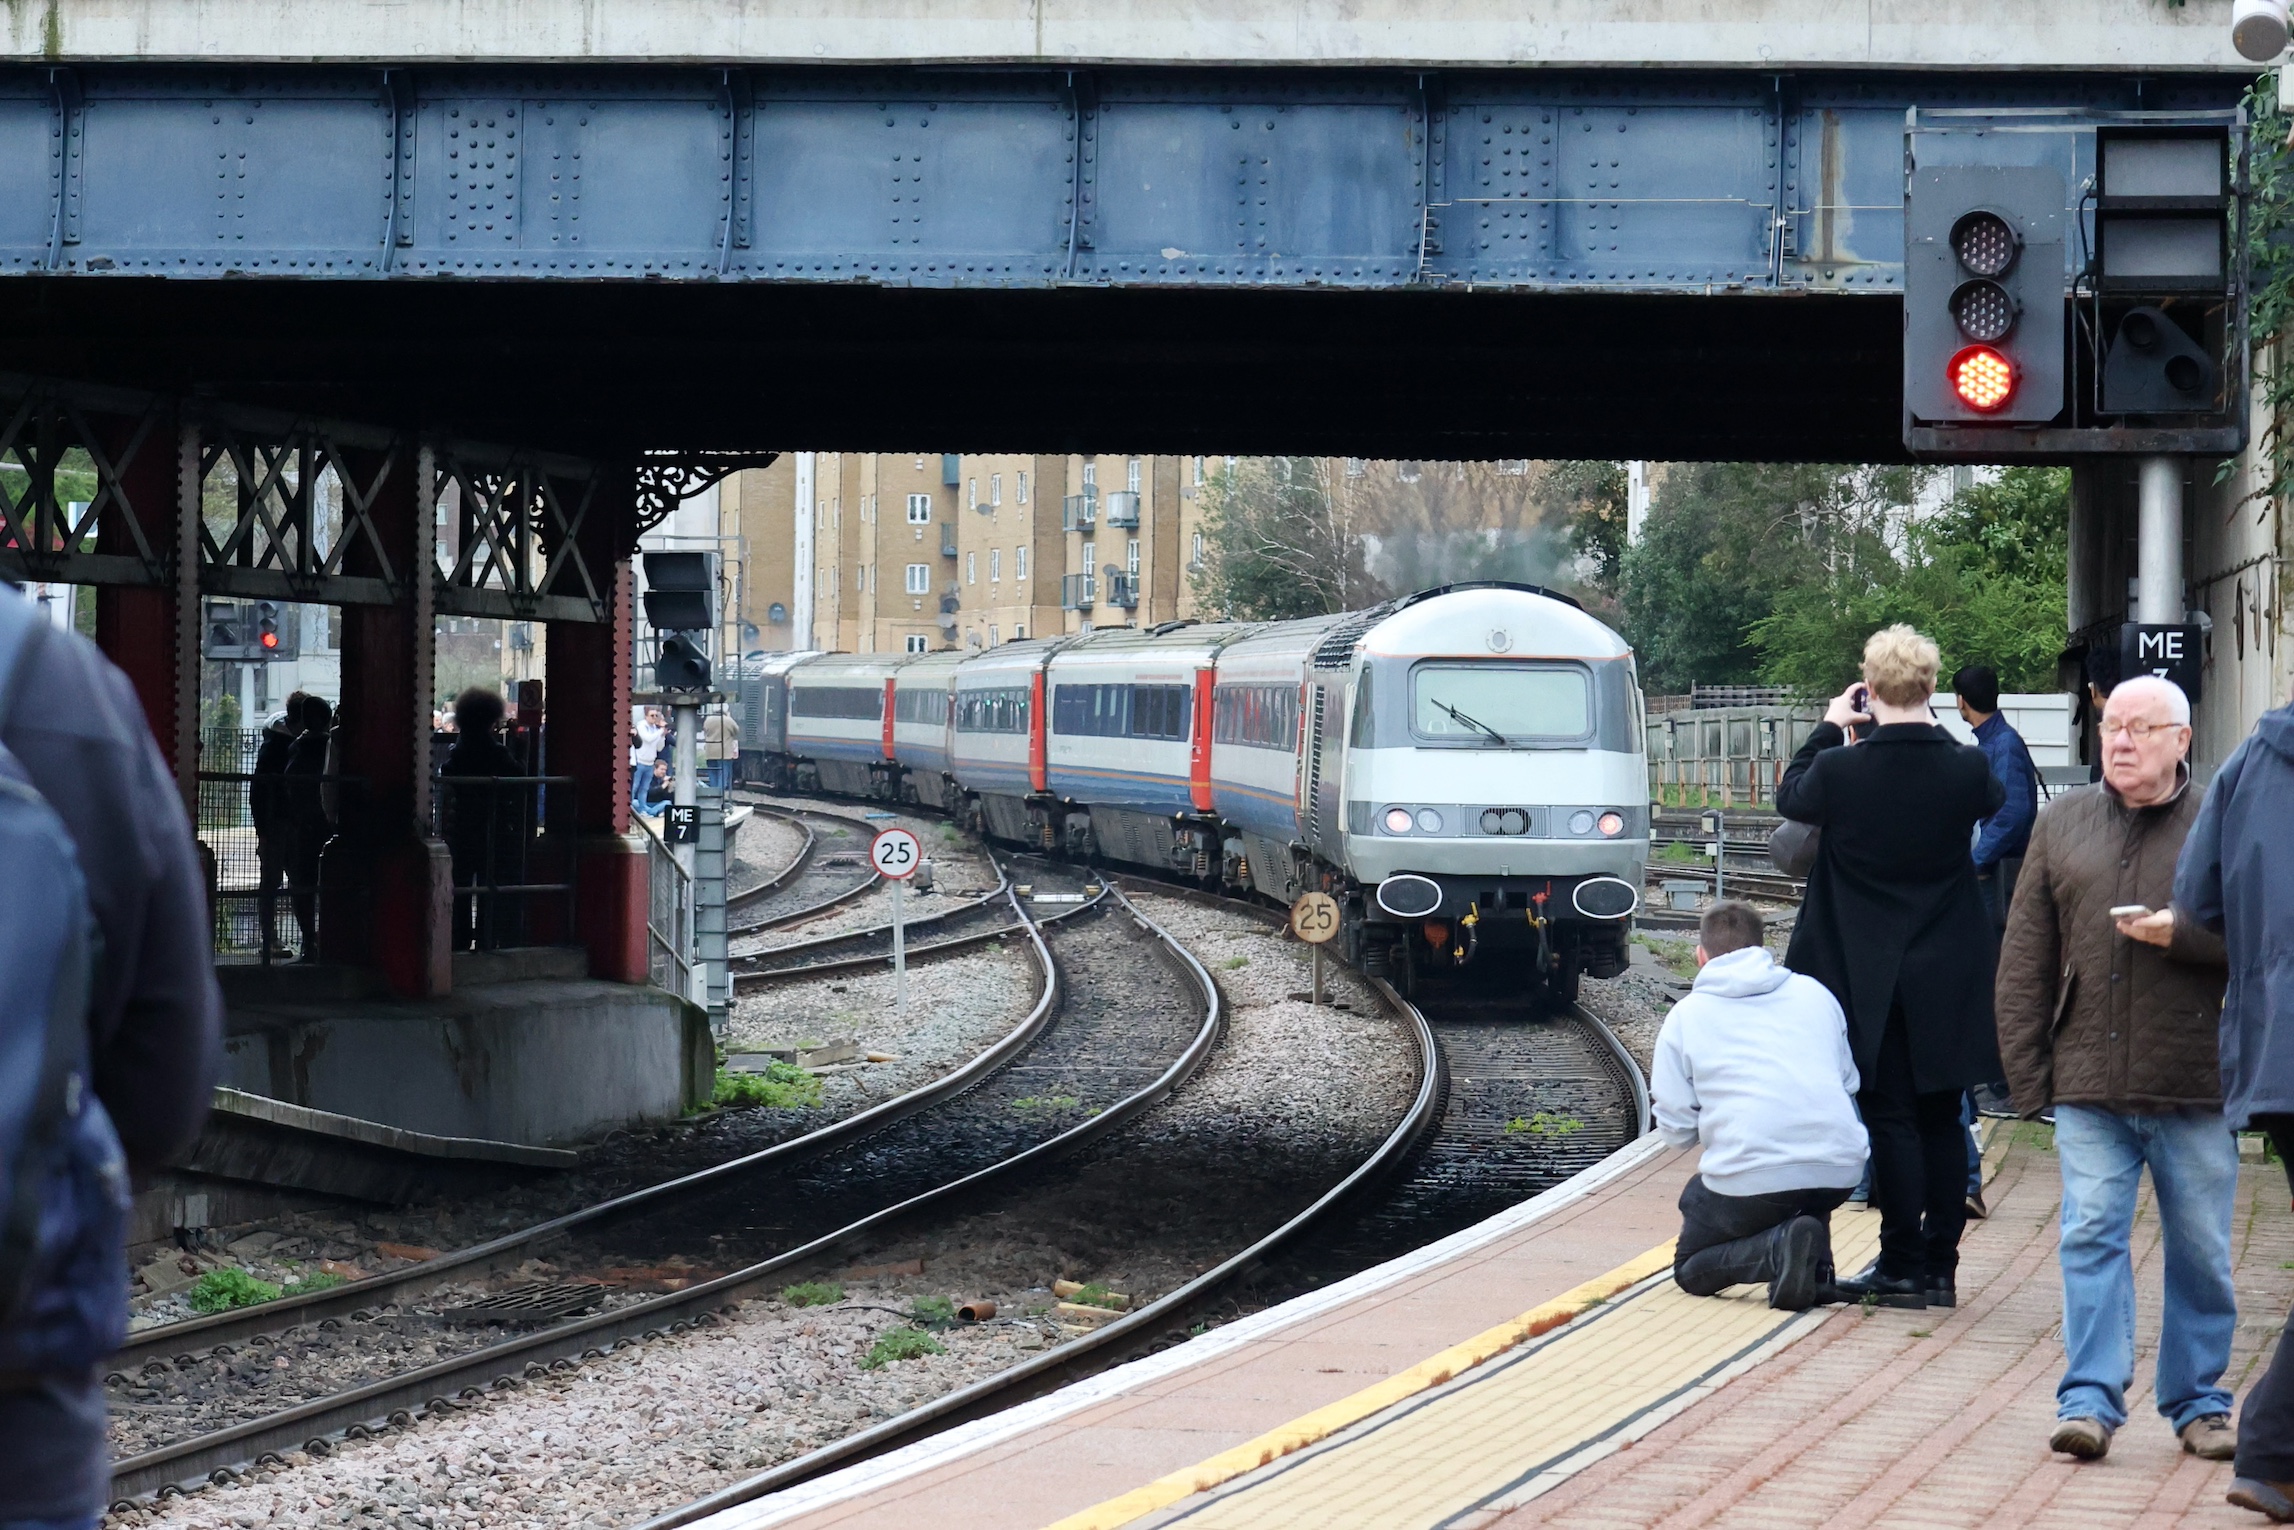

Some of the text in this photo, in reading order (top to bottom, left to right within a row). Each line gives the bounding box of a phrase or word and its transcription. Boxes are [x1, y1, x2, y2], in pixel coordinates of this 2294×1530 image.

[2138, 631, 2184, 659] ME
[671, 808, 694, 823] ME
[677, 825, 687, 840] 7
[881, 842, 912, 864] 25
[1301, 904, 1332, 930] 25
